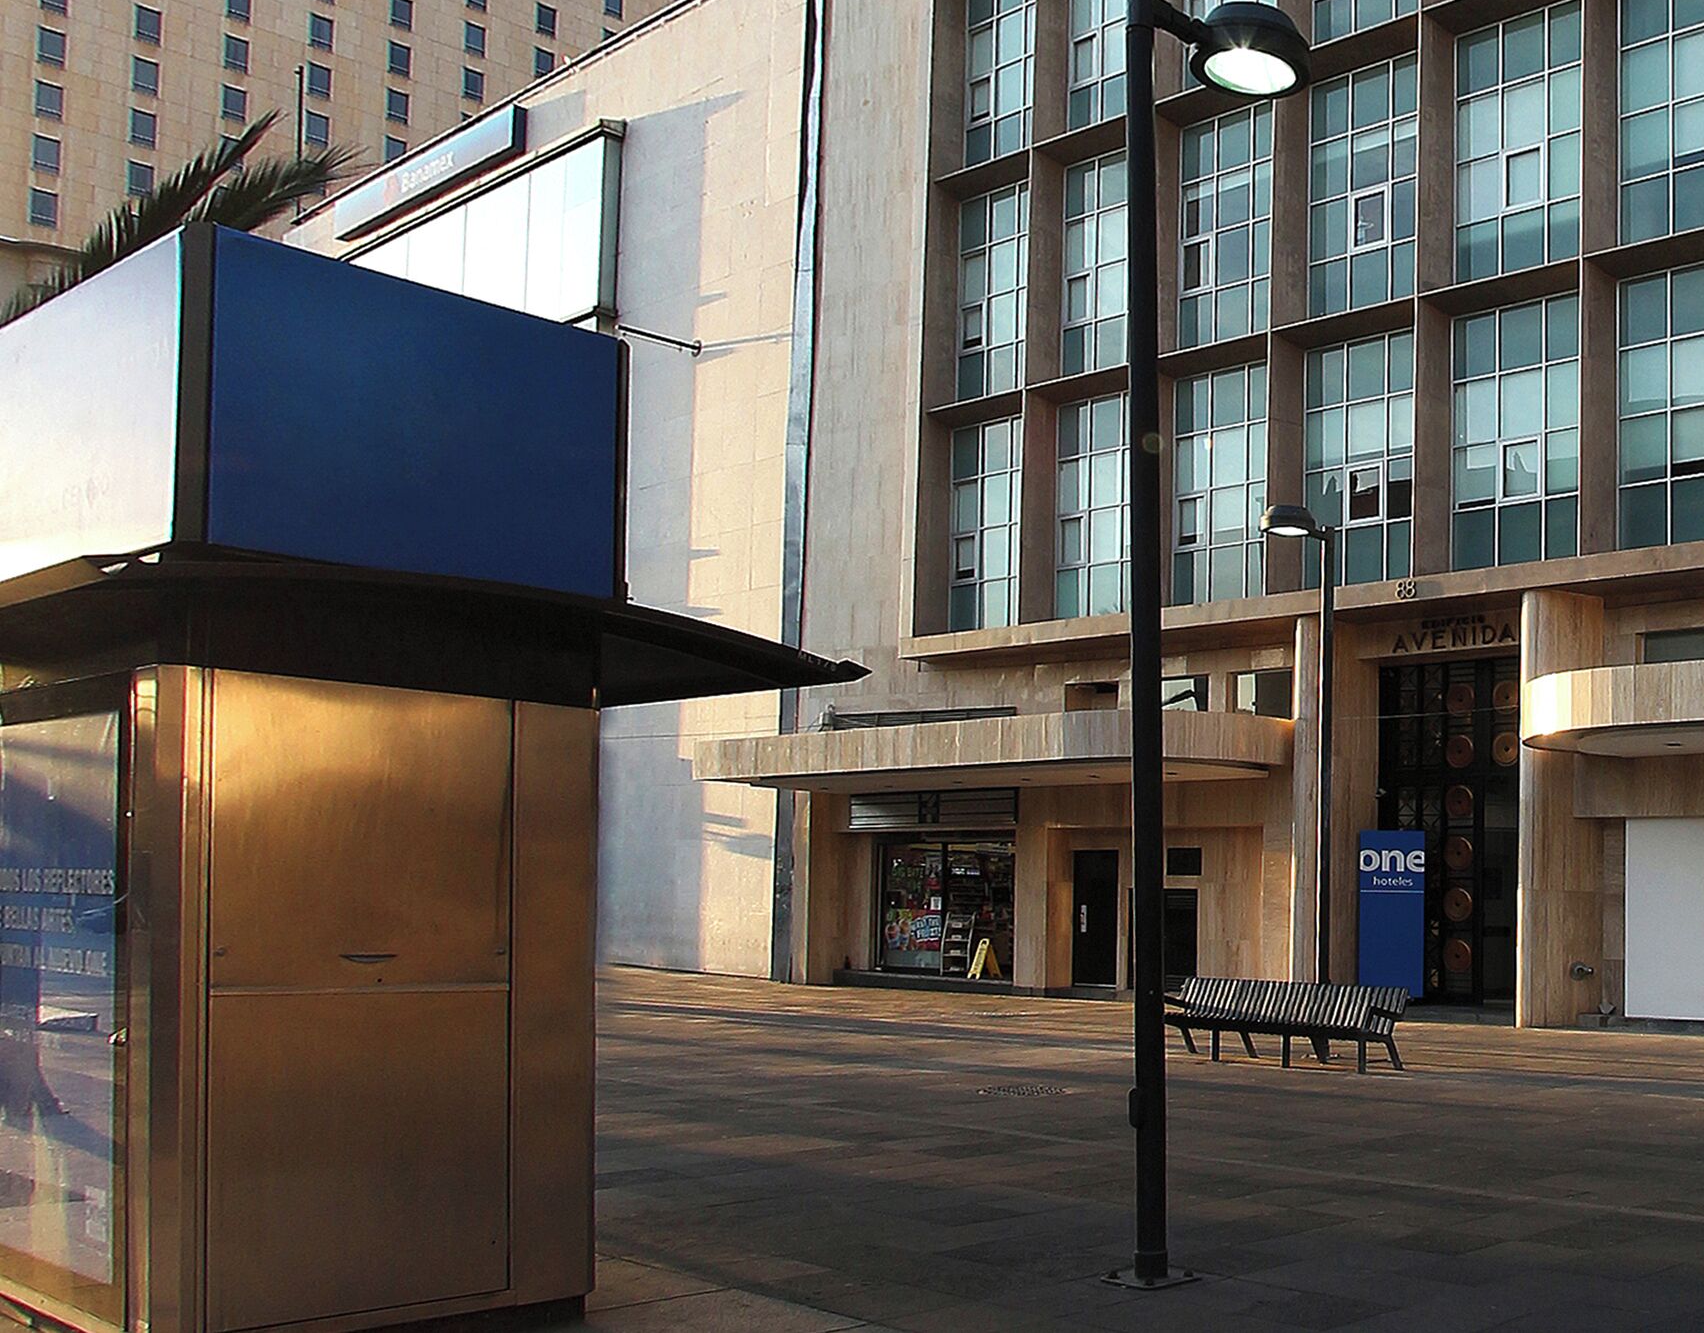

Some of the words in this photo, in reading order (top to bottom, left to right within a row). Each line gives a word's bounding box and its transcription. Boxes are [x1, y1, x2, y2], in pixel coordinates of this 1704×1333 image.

[401, 151, 455, 194] Banamex
[1395, 579, 1416, 599] 88
[1392, 623, 1517, 654] AVENIDA
[1360, 849, 1425, 872] one
[43, 869, 114, 895] REFLECTORES
[1373, 876, 1413, 886] hoteles
[3, 906, 39, 931] BELLAS
